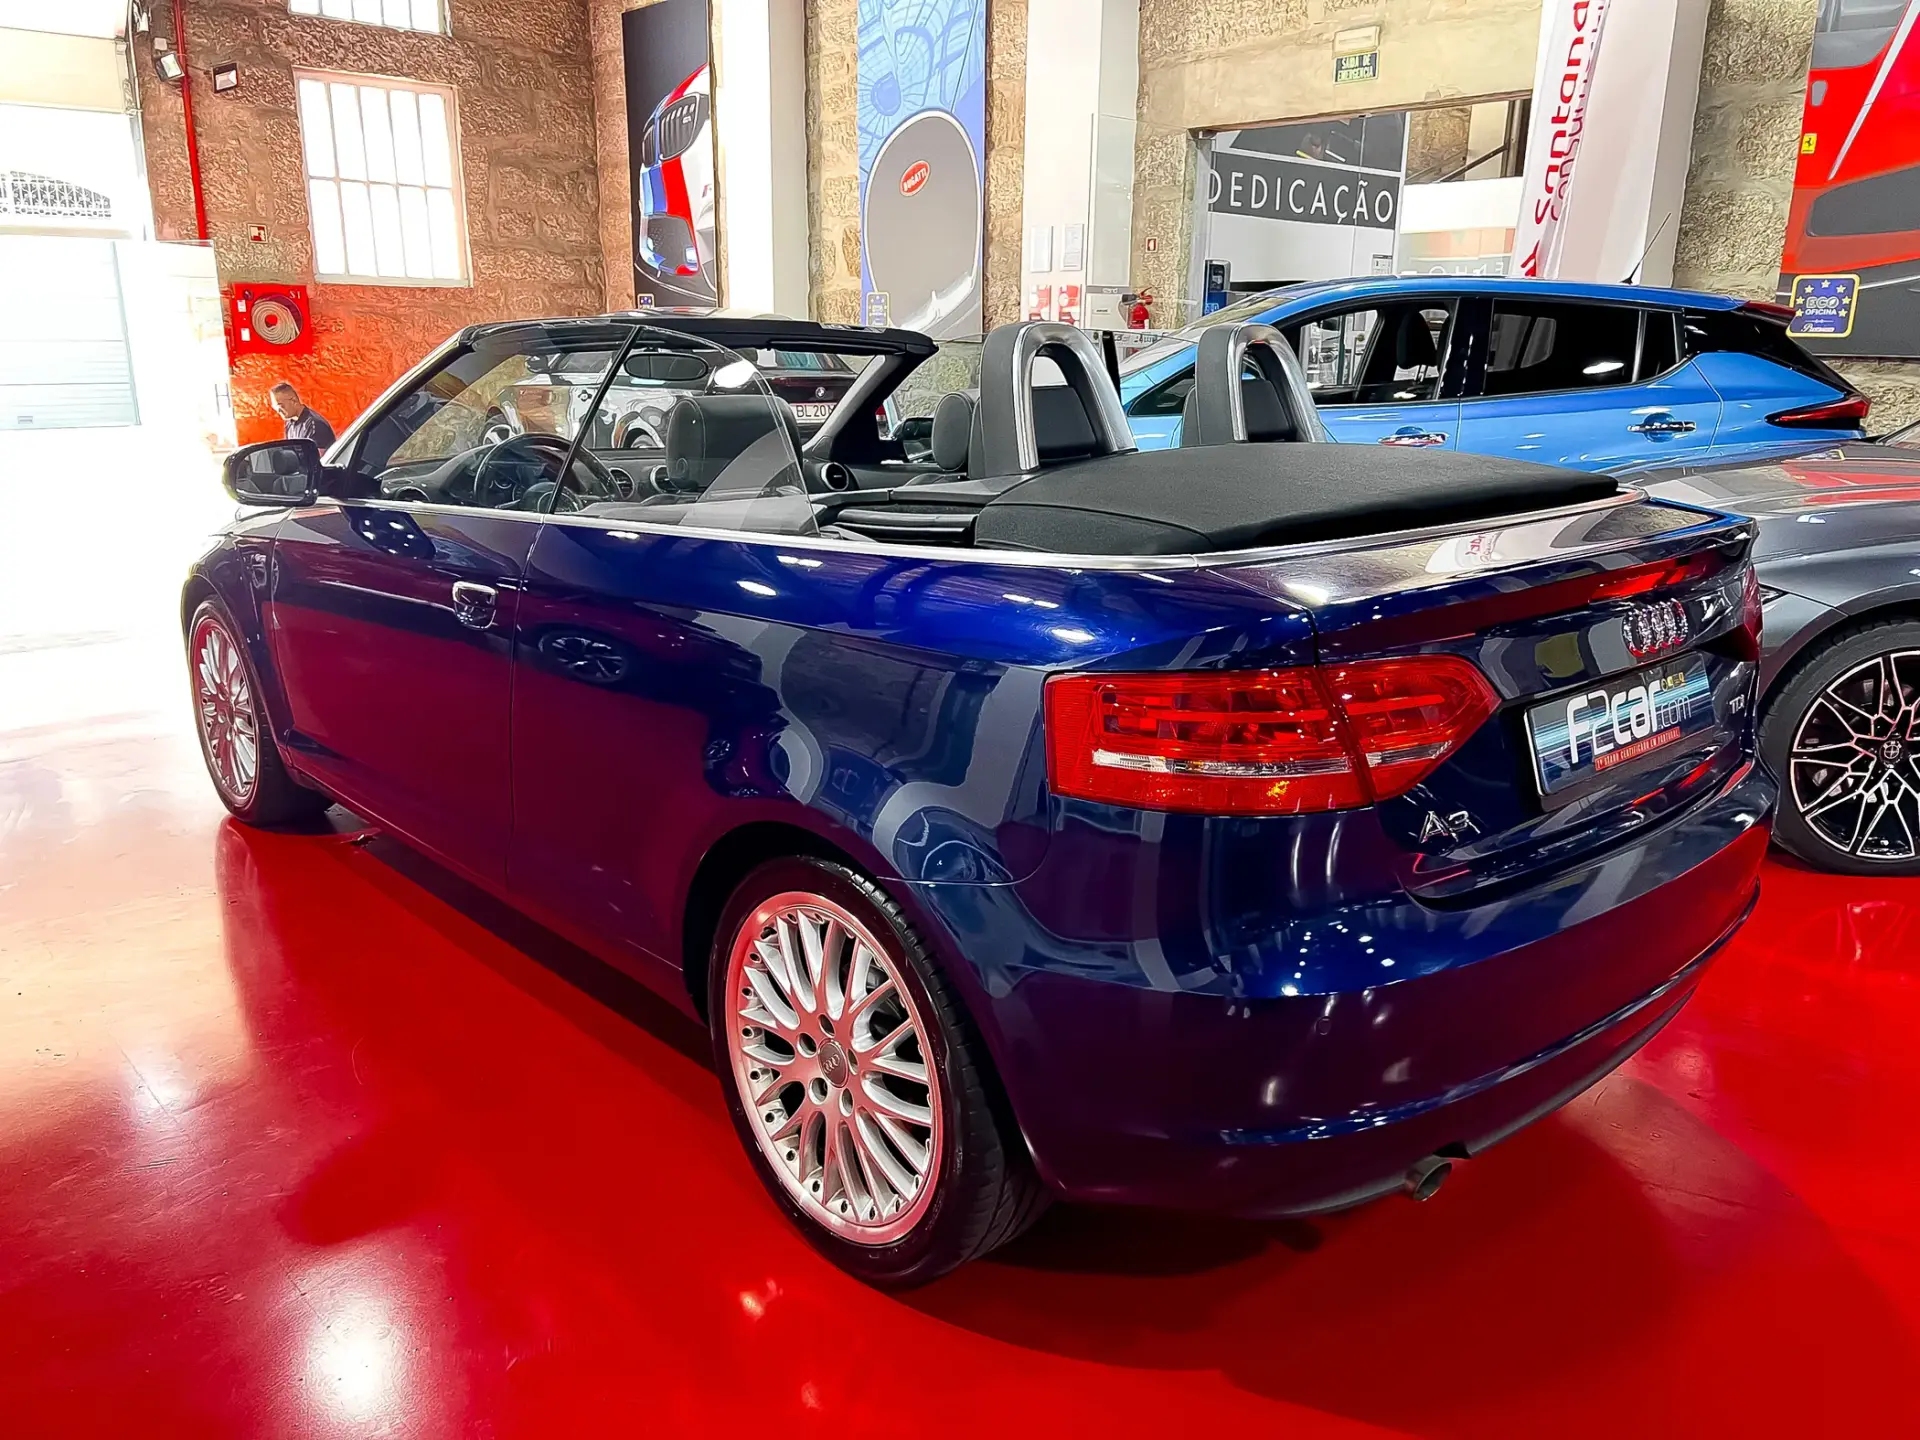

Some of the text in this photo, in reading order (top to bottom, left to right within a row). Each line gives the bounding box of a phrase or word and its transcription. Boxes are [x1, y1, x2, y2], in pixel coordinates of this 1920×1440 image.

[1208, 168, 1393, 224] DEDICAÇÃO
[1805, 308, 1837, 316] OFICINA
[1806, 296, 1840, 309] ECO
[1419, 810, 1471, 843] A3
